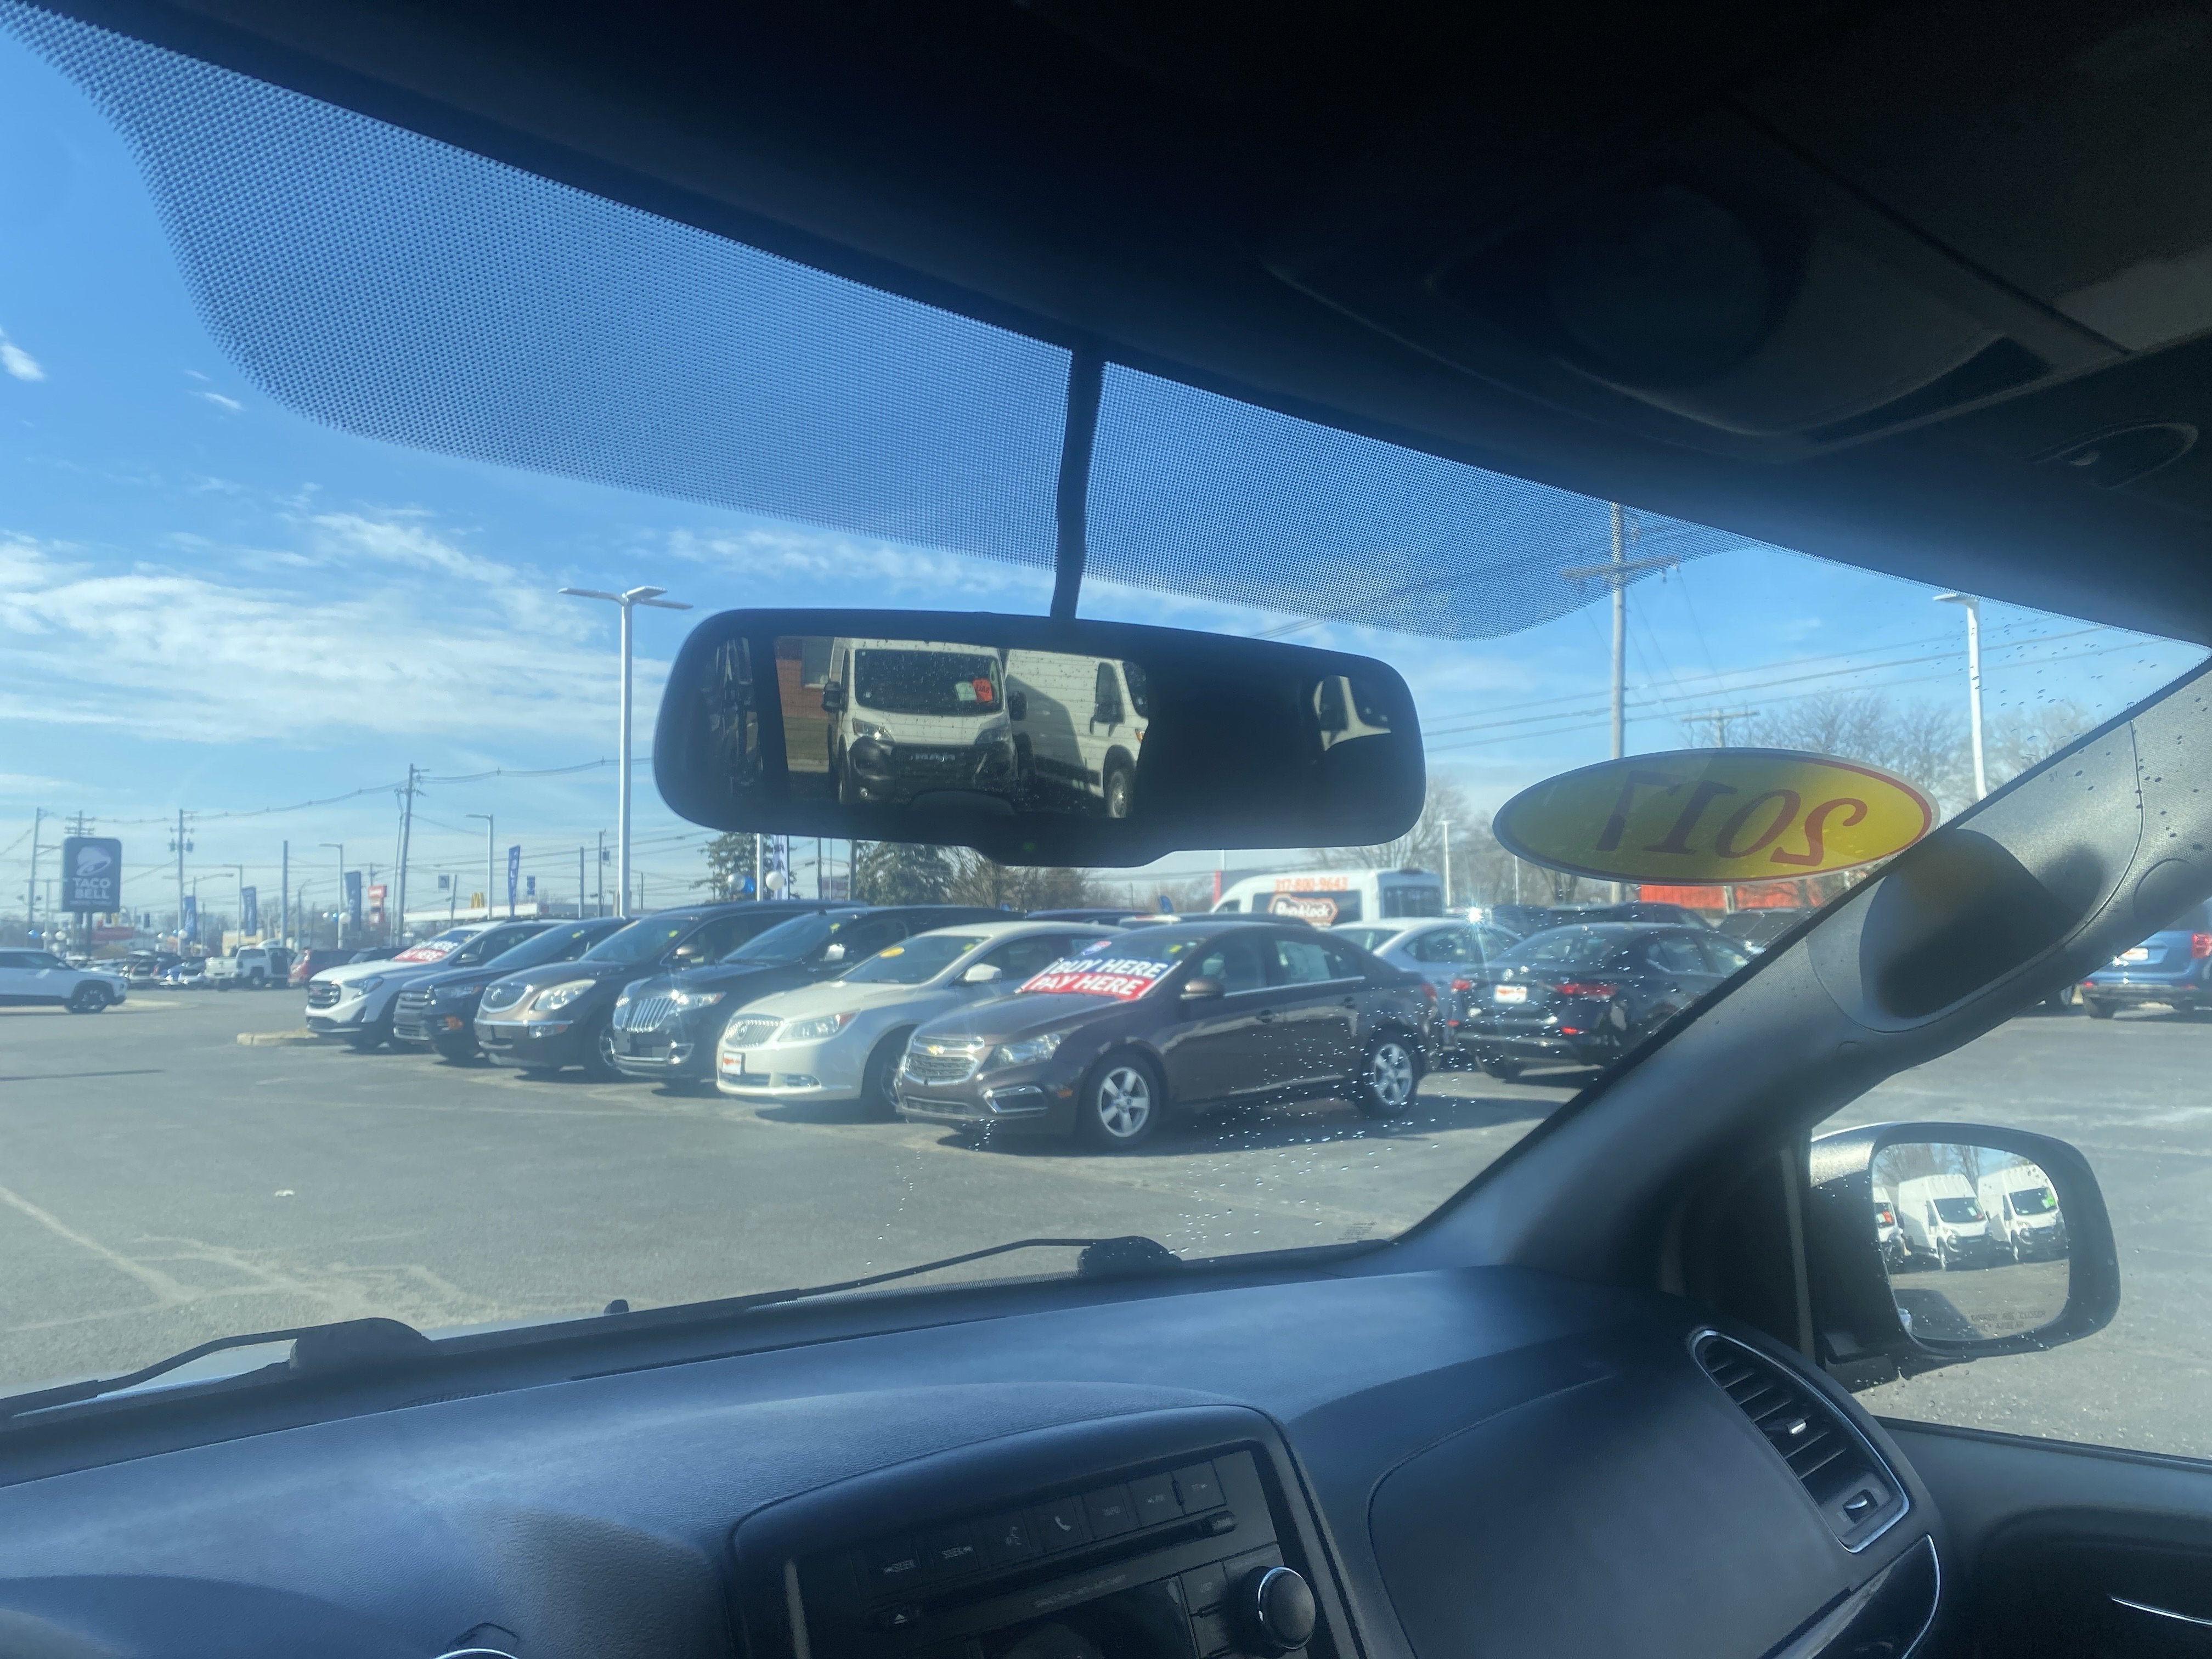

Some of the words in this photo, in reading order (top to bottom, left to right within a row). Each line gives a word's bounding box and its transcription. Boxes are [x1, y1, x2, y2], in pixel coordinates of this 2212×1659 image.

[72, 877, 111, 888] TACO
[75, 888, 109, 899] BELL
[1049, 958, 1103, 975] BUY
[1096, 958, 1168, 978] HERE
[1034, 974, 1079, 989] PAY
[1073, 974, 1144, 995] HERE
